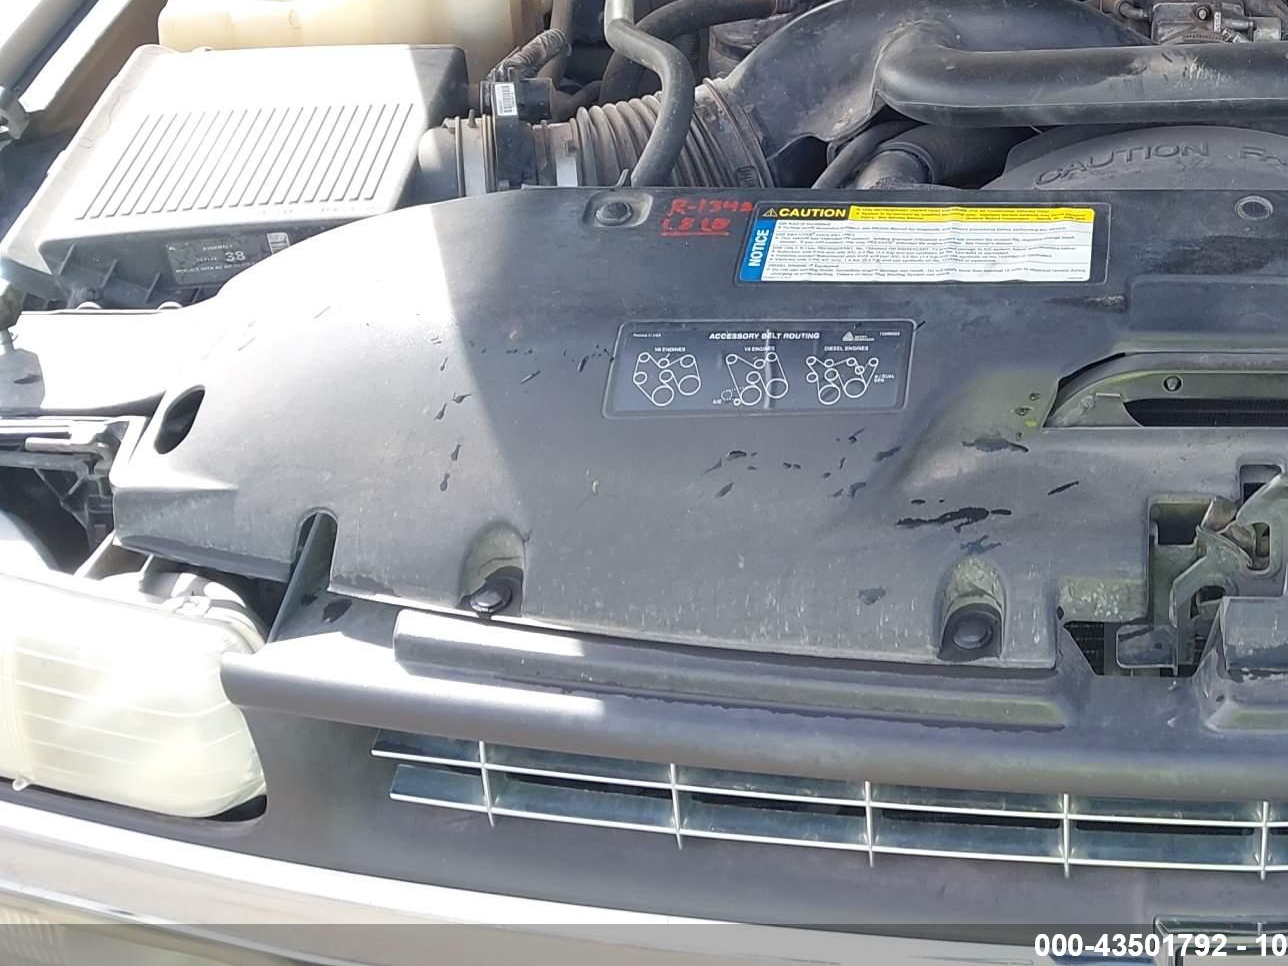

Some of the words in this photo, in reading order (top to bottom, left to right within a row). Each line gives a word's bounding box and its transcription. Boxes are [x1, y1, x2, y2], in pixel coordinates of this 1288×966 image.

[1034, 142, 1210, 187] CAUTION
[778, 207, 847, 219] CAUTION
[748, 229, 770, 267] NOTICE
[225, 250, 246, 262] 38
[709, 332, 760, 340] ACCESSORY
